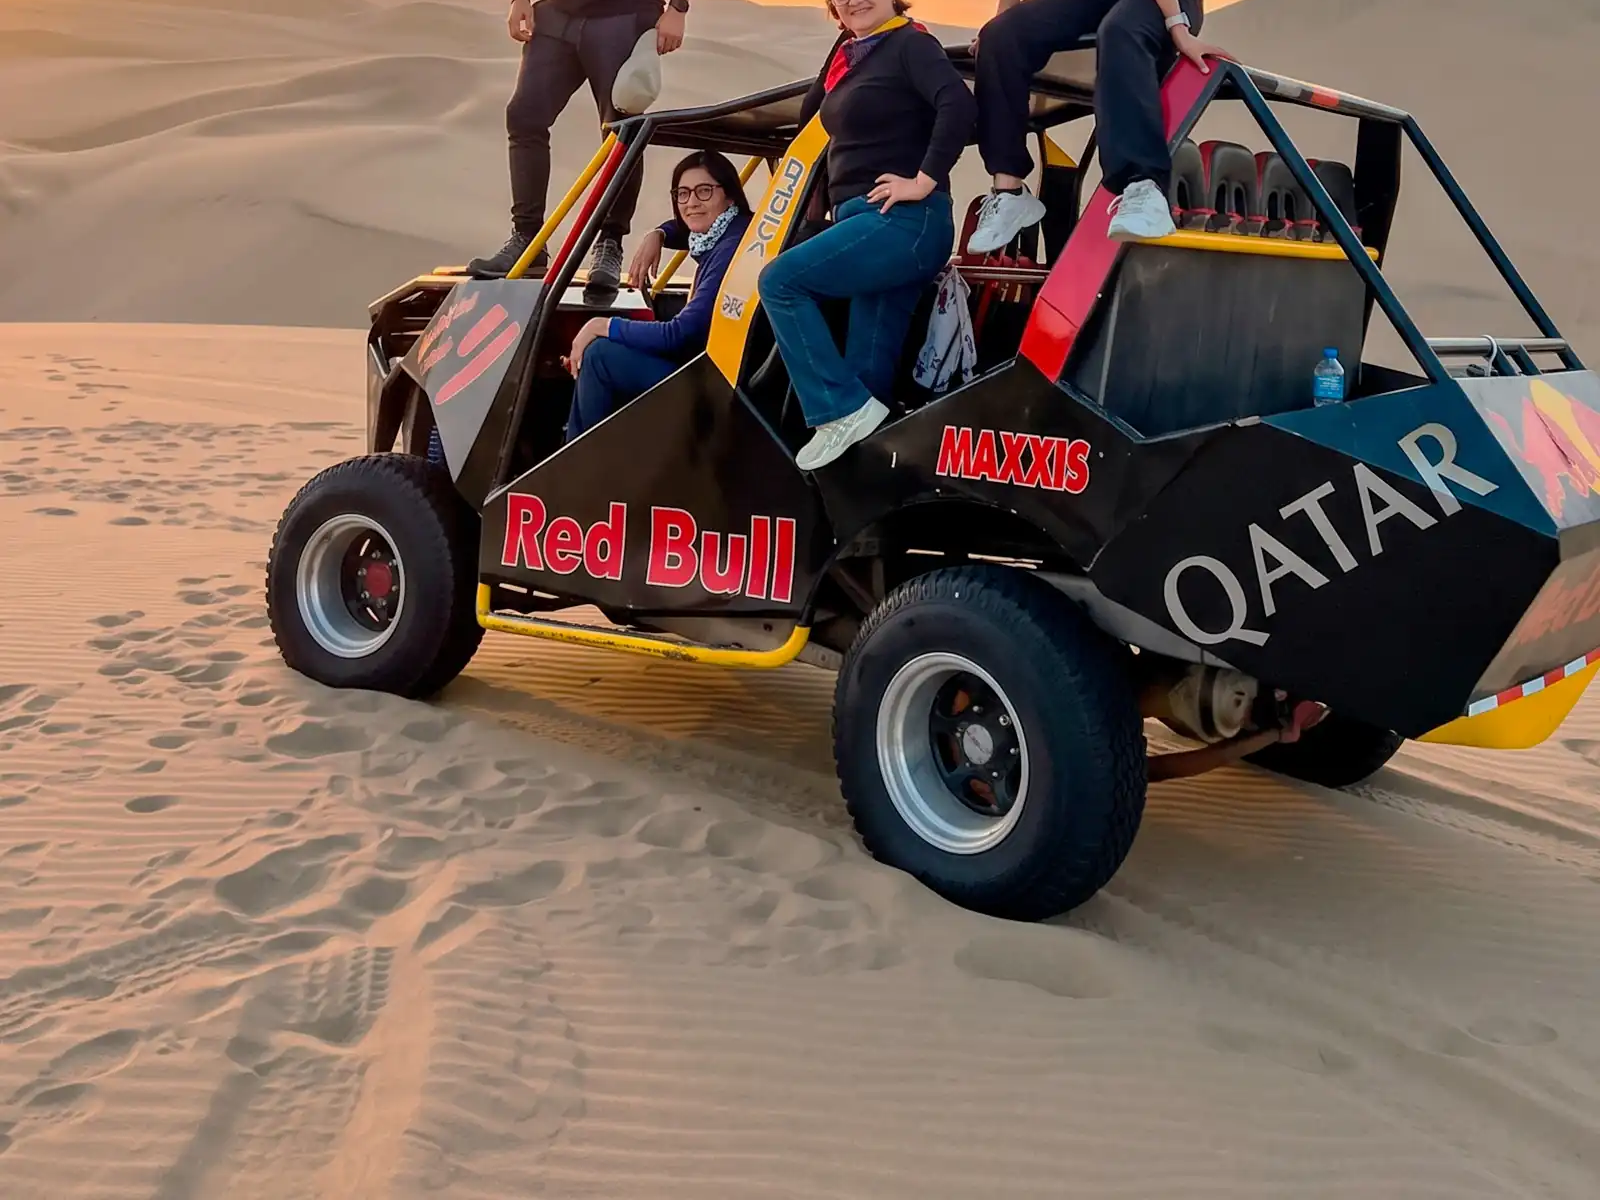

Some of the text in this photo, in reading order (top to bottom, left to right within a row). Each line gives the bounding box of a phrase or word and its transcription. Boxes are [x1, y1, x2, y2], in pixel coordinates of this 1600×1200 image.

[936, 425, 1091, 494] MAXXIS
[501, 492, 796, 603] Red Bull
[1163, 422, 1499, 647] QATAR
